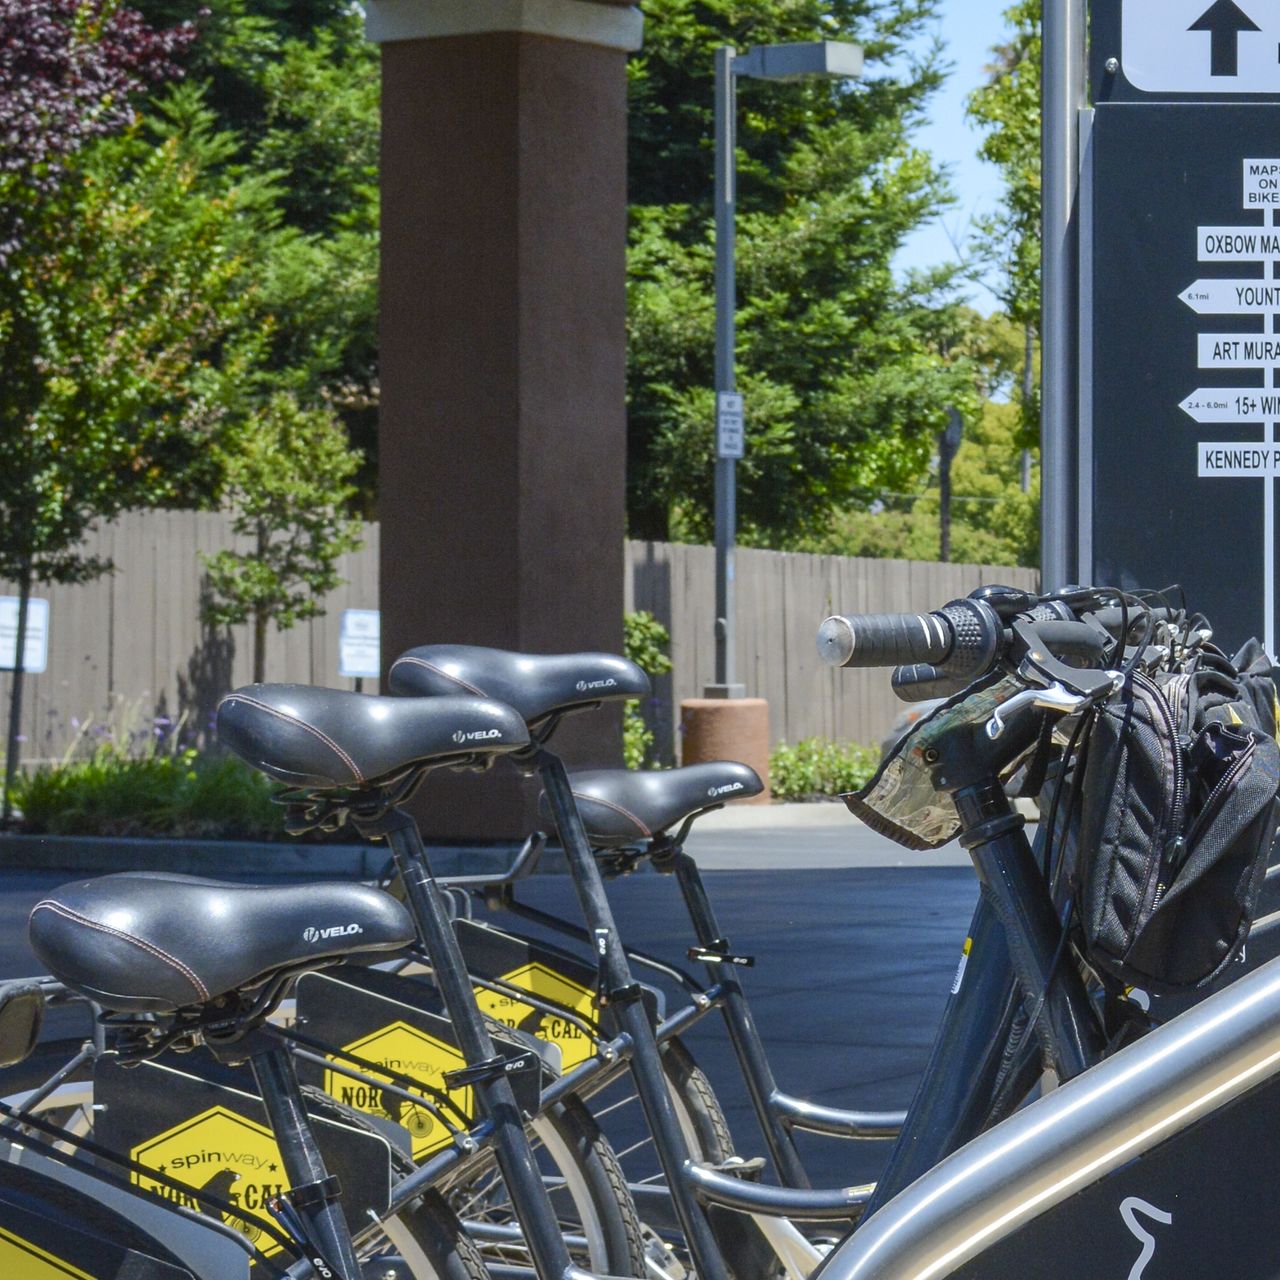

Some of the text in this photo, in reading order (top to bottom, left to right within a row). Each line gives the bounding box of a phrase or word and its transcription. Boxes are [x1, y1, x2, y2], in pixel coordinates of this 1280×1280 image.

[1258, 179, 1278, 189] ON
[1205, 235, 1257, 254] OXBOW
[1213, 342, 1240, 360] ART
[1235, 397, 1257, 415] 15+
[1205, 450, 1270, 469] KENNEDY
[320, 923, 361, 939] VELO
[171, 1150, 269, 1170] spinway
